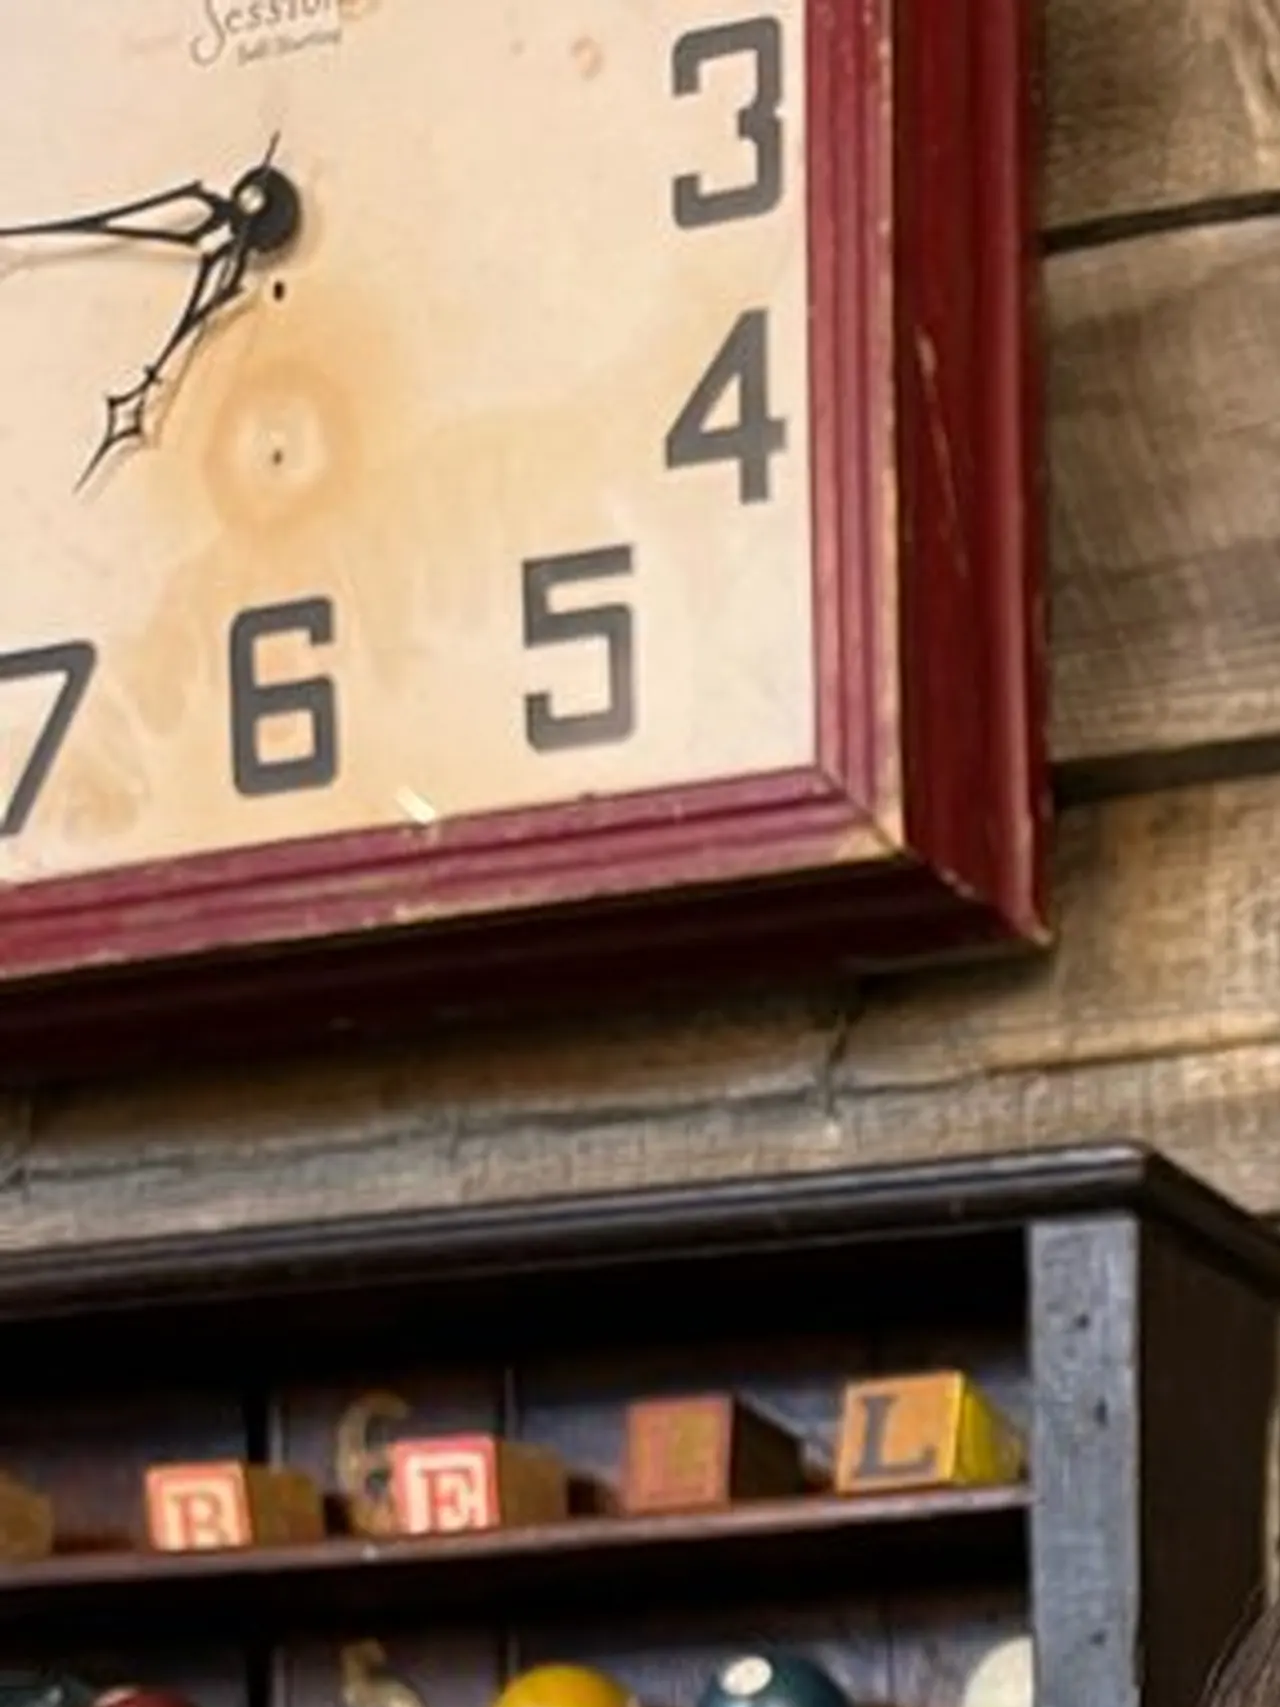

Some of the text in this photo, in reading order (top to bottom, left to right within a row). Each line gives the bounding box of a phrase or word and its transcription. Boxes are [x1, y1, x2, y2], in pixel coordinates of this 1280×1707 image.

[671, 15, 785, 230] 3
[664, 308, 787, 504] 4
[0, 640, 96, 836] 7
[229, 596, 336, 797] 6
[522, 544, 636, 752] 5
[421, 1466, 480, 1529] E
[854, 1394, 938, 1479] L
